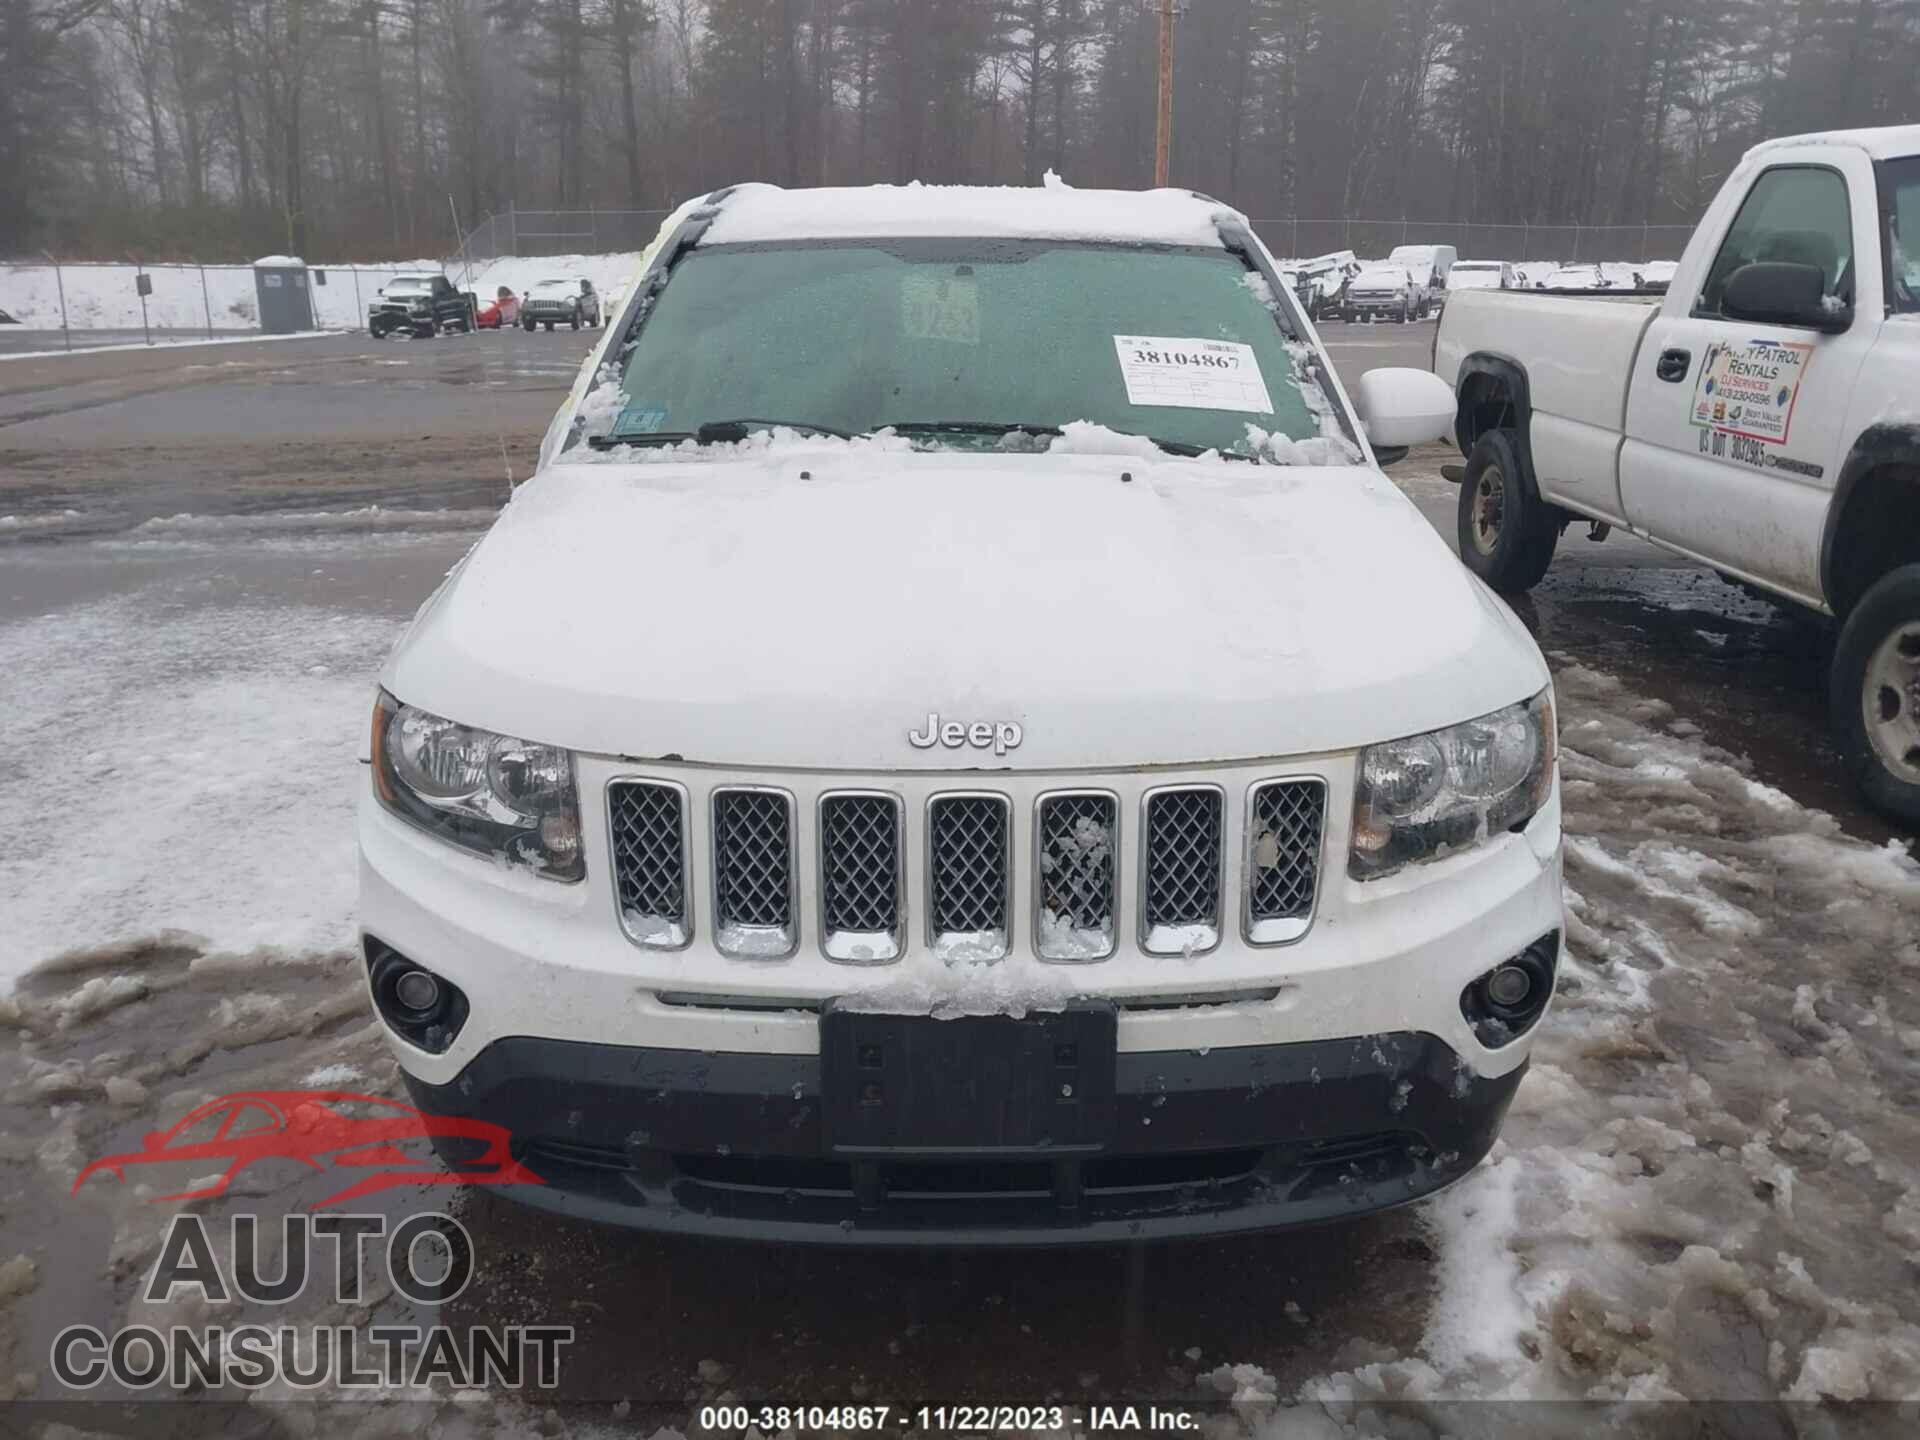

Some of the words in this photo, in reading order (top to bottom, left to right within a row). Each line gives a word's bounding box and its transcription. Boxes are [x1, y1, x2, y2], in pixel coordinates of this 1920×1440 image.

[1133, 350, 1240, 369] 38104867
[1754, 345, 1801, 365] PATROL
[1728, 359, 1780, 379] RENTALS
[1712, 431, 1727, 457] DOT
[909, 713, 1023, 756] Jeep
